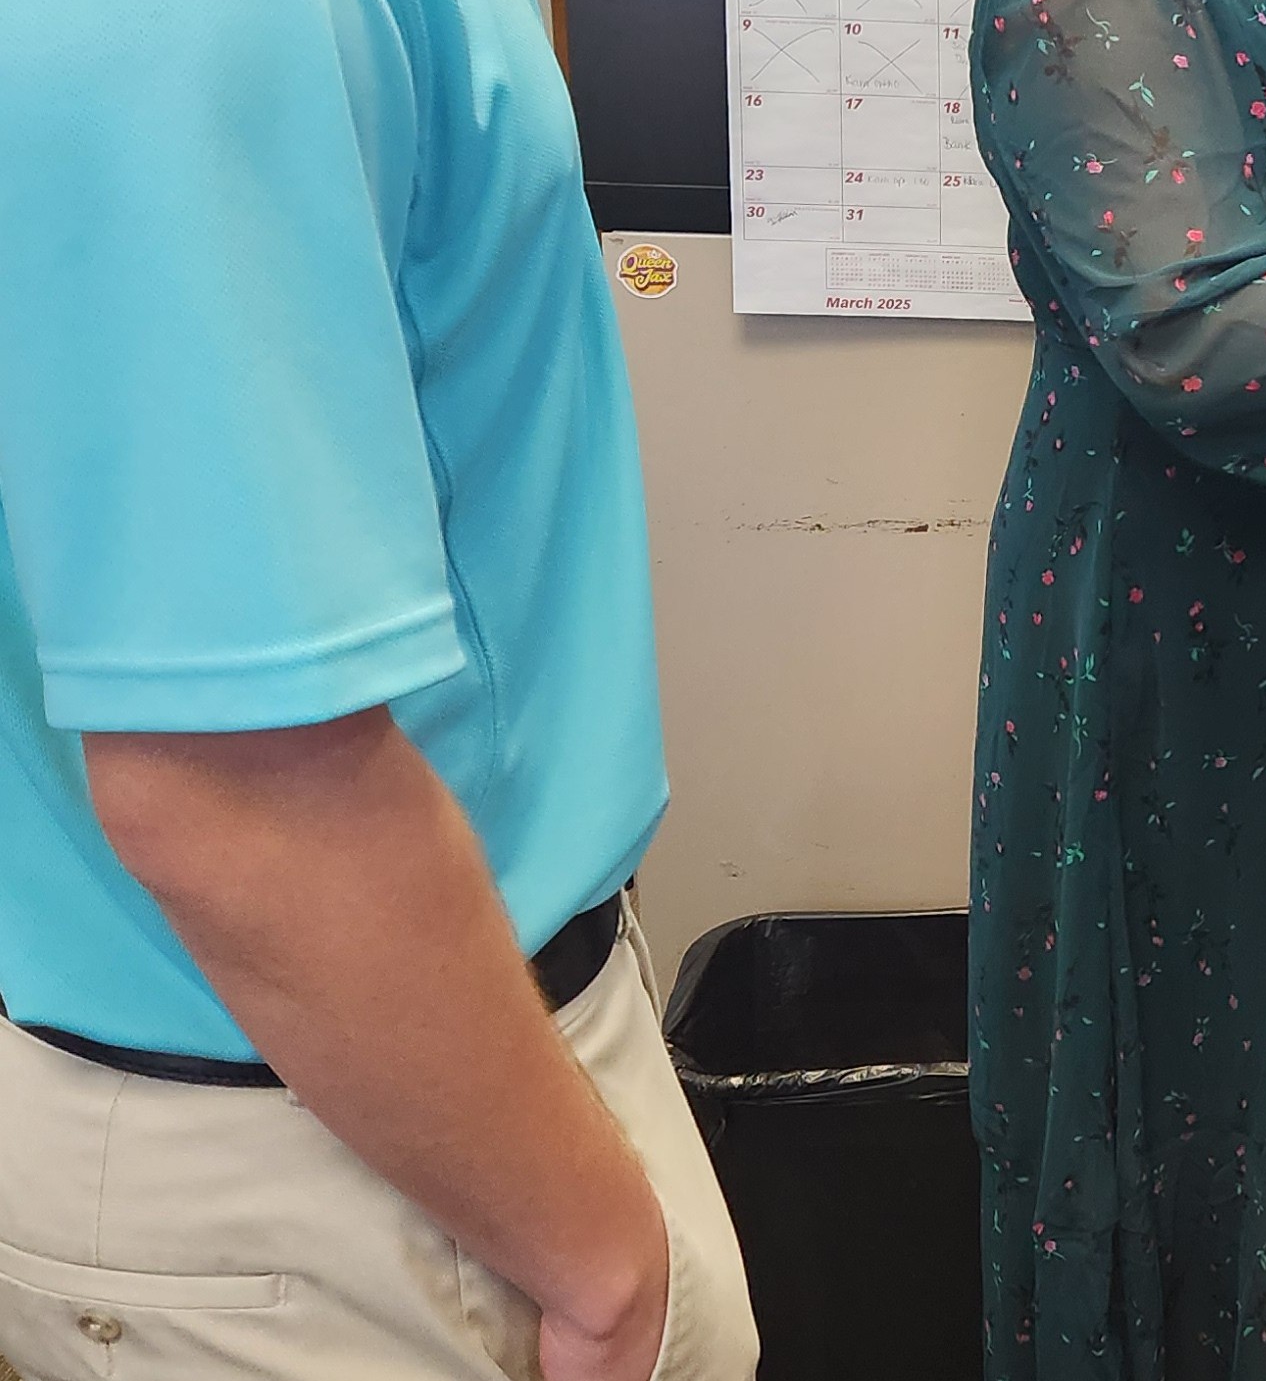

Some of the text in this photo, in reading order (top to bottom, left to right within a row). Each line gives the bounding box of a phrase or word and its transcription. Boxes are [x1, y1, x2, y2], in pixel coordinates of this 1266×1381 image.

[742, 19, 752, 31] 9
[844, 23, 862, 35] 10
[942, 27, 960, 39] 11
[745, 95, 763, 107] 16
[844, 98, 863, 110] 17
[943, 102, 961, 114] 18
[745, 169, 764, 181] 23
[844, 172, 864, 183] 24
[943, 175, 962, 187] 25
[746, 206, 765, 218] 30
[845, 208, 864, 221] 31
[620, 251, 675, 275] Queen
[633, 268, 674, 290] Jax
[826, 297, 911, 310] March 2025
